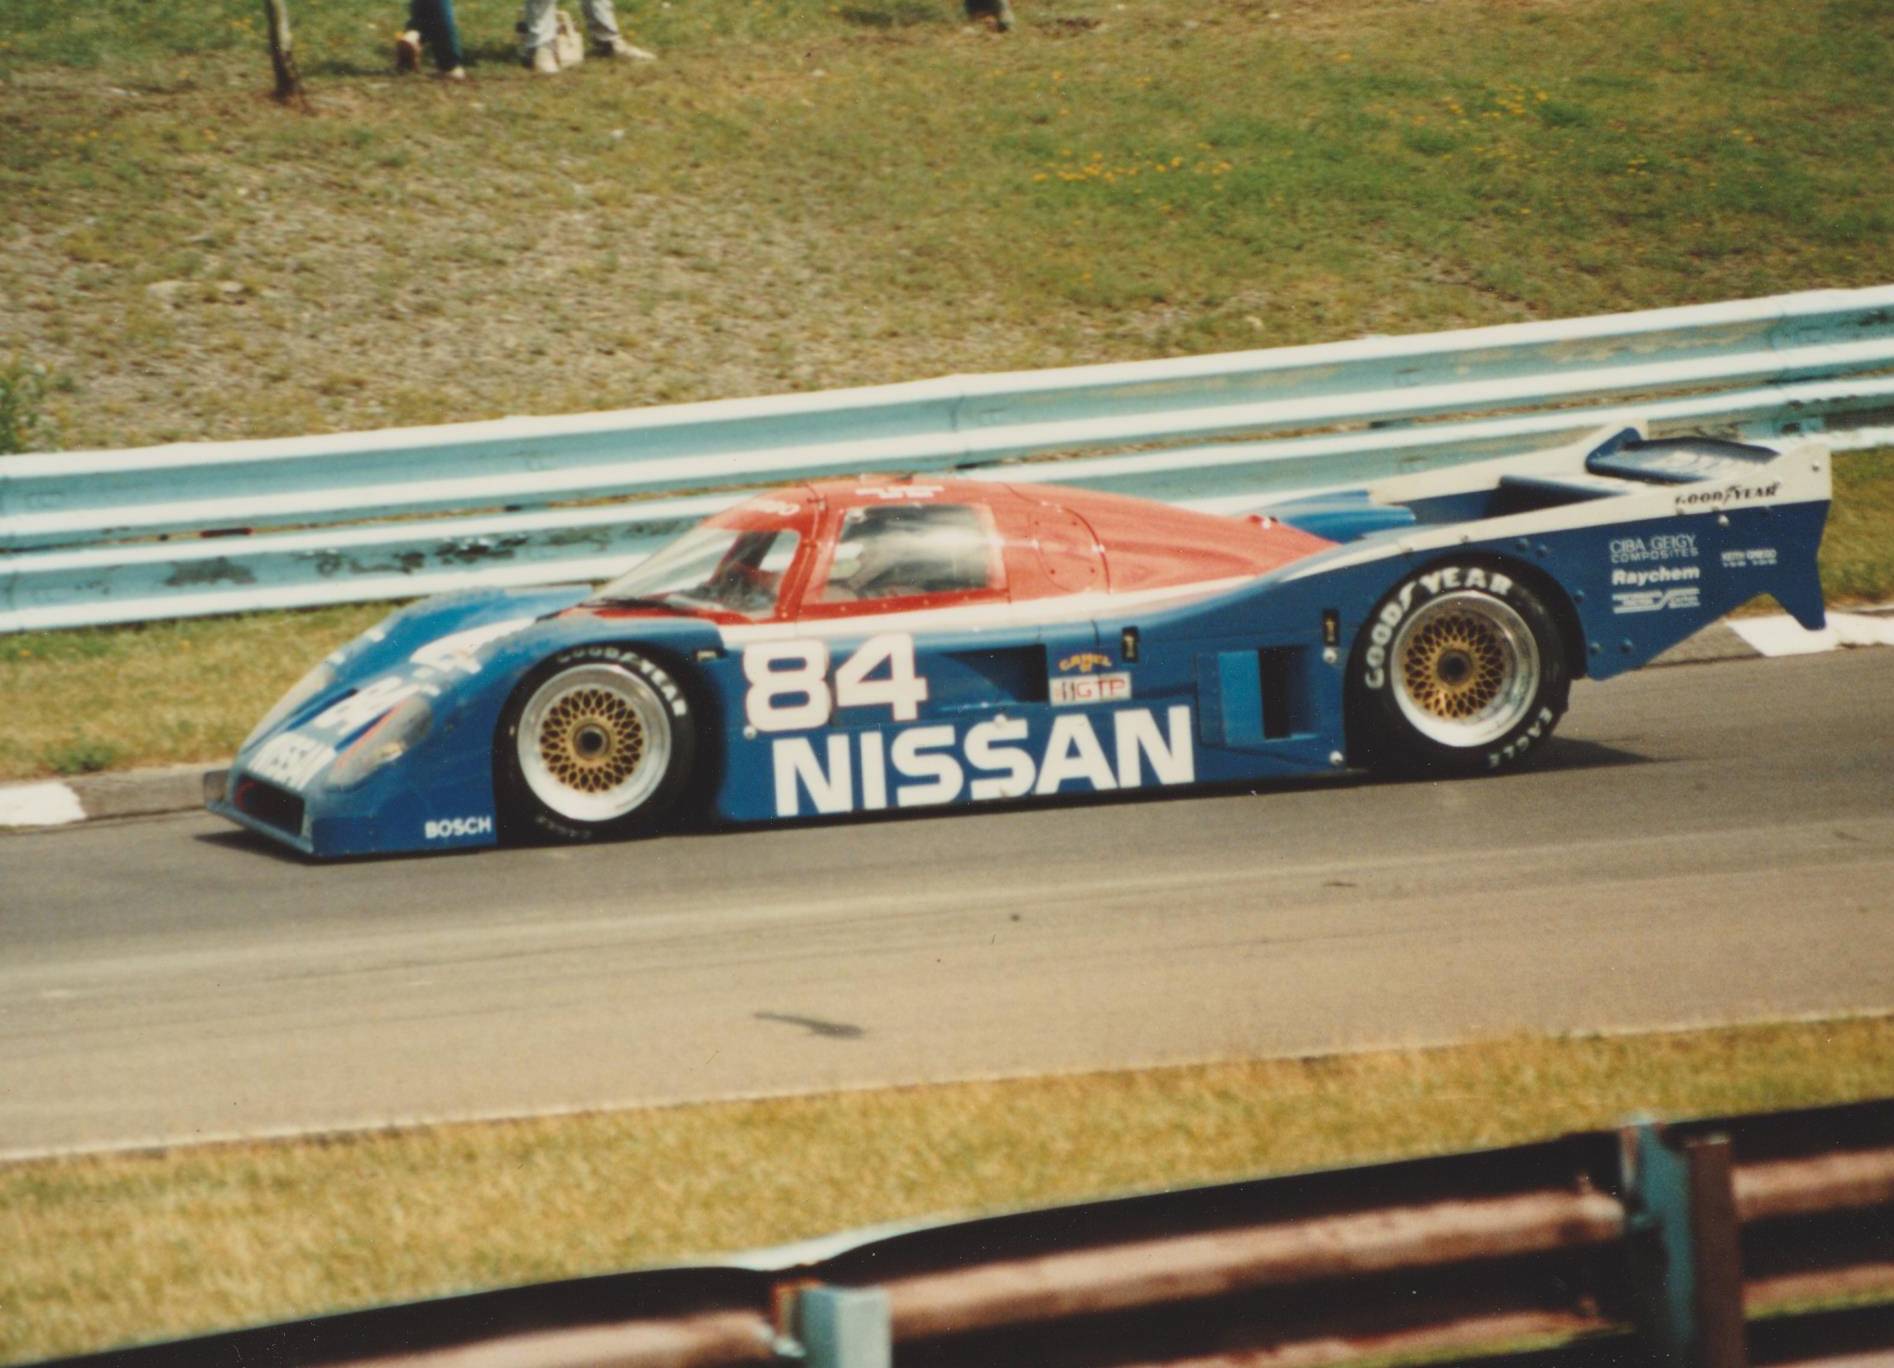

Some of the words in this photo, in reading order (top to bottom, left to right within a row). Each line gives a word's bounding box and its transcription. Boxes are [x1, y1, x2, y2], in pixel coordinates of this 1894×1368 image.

[1651, 535, 1697, 550] GEIGY
[1611, 549, 1699, 563] COMPOSITES
[1612, 566, 1699, 586] Raychem
[1364, 567, 1513, 689] GOODYEAR
[742, 633, 928, 732] 84
[772, 704, 1196, 818] NISSAN
[424, 816, 492, 839] BOSCH
